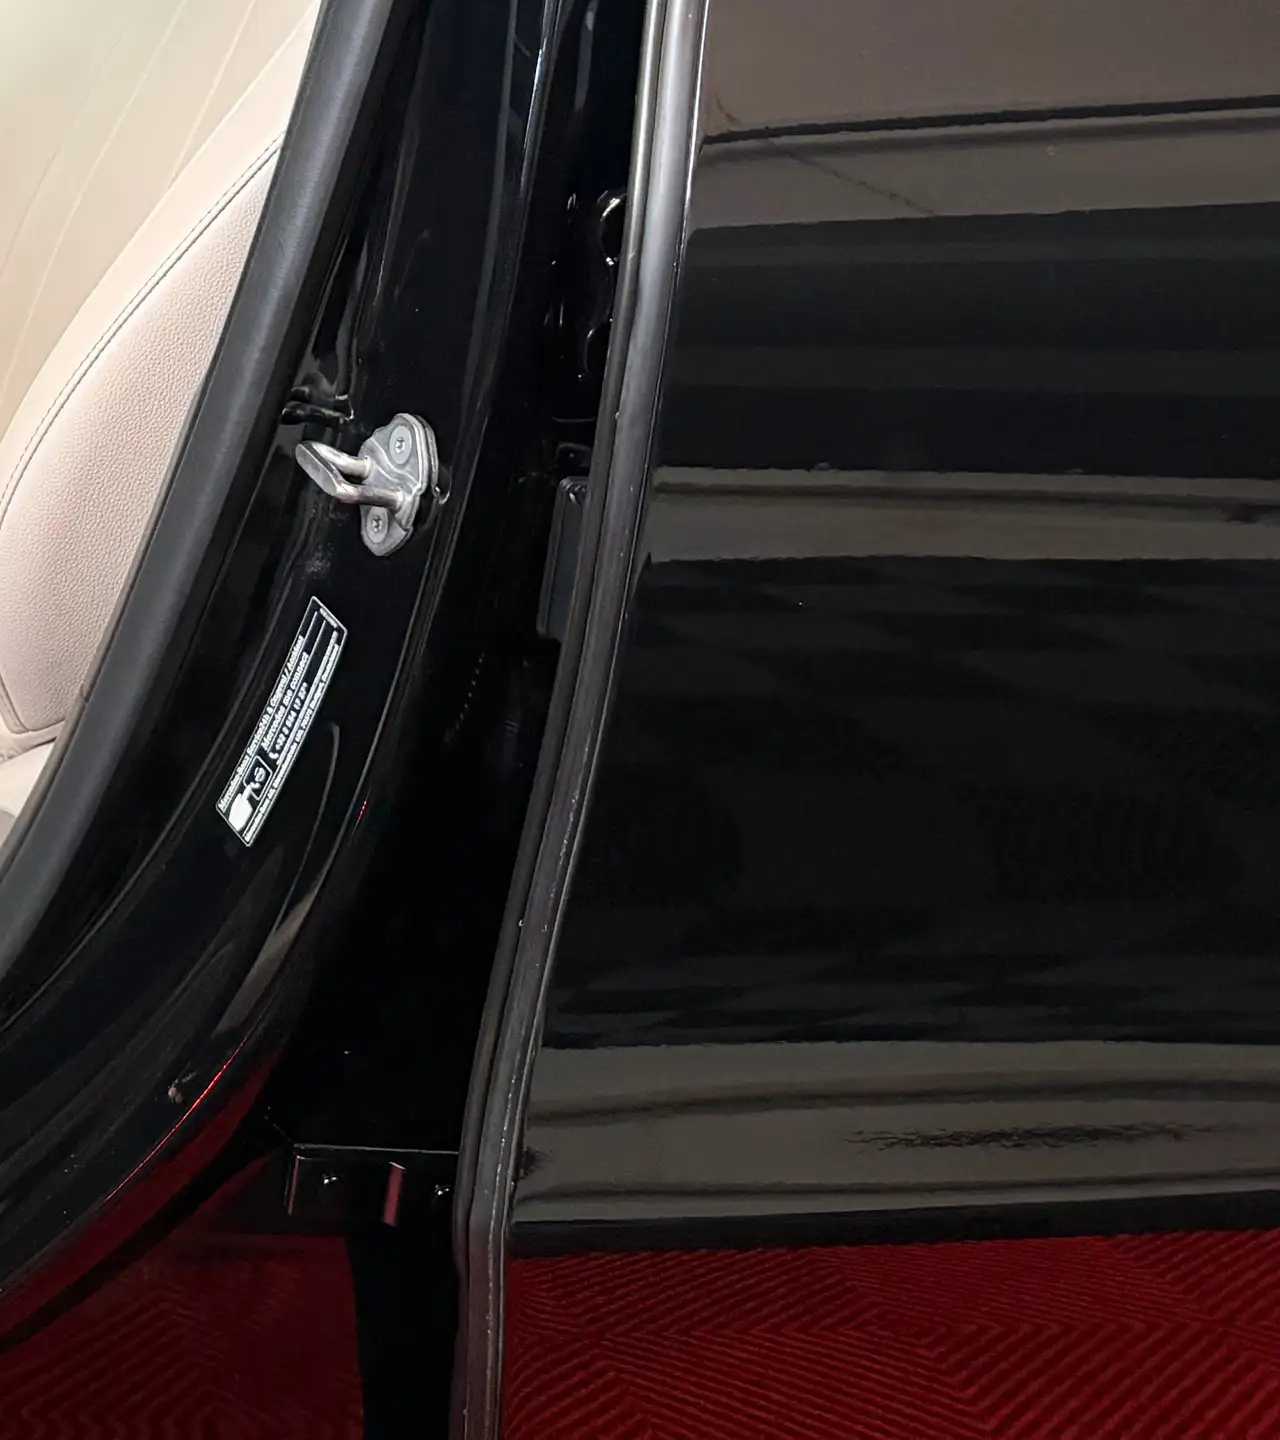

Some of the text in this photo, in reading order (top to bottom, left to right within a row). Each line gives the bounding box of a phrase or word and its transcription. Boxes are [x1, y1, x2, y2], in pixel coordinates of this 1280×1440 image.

[260, 649, 309, 751] Mercedes me connect
